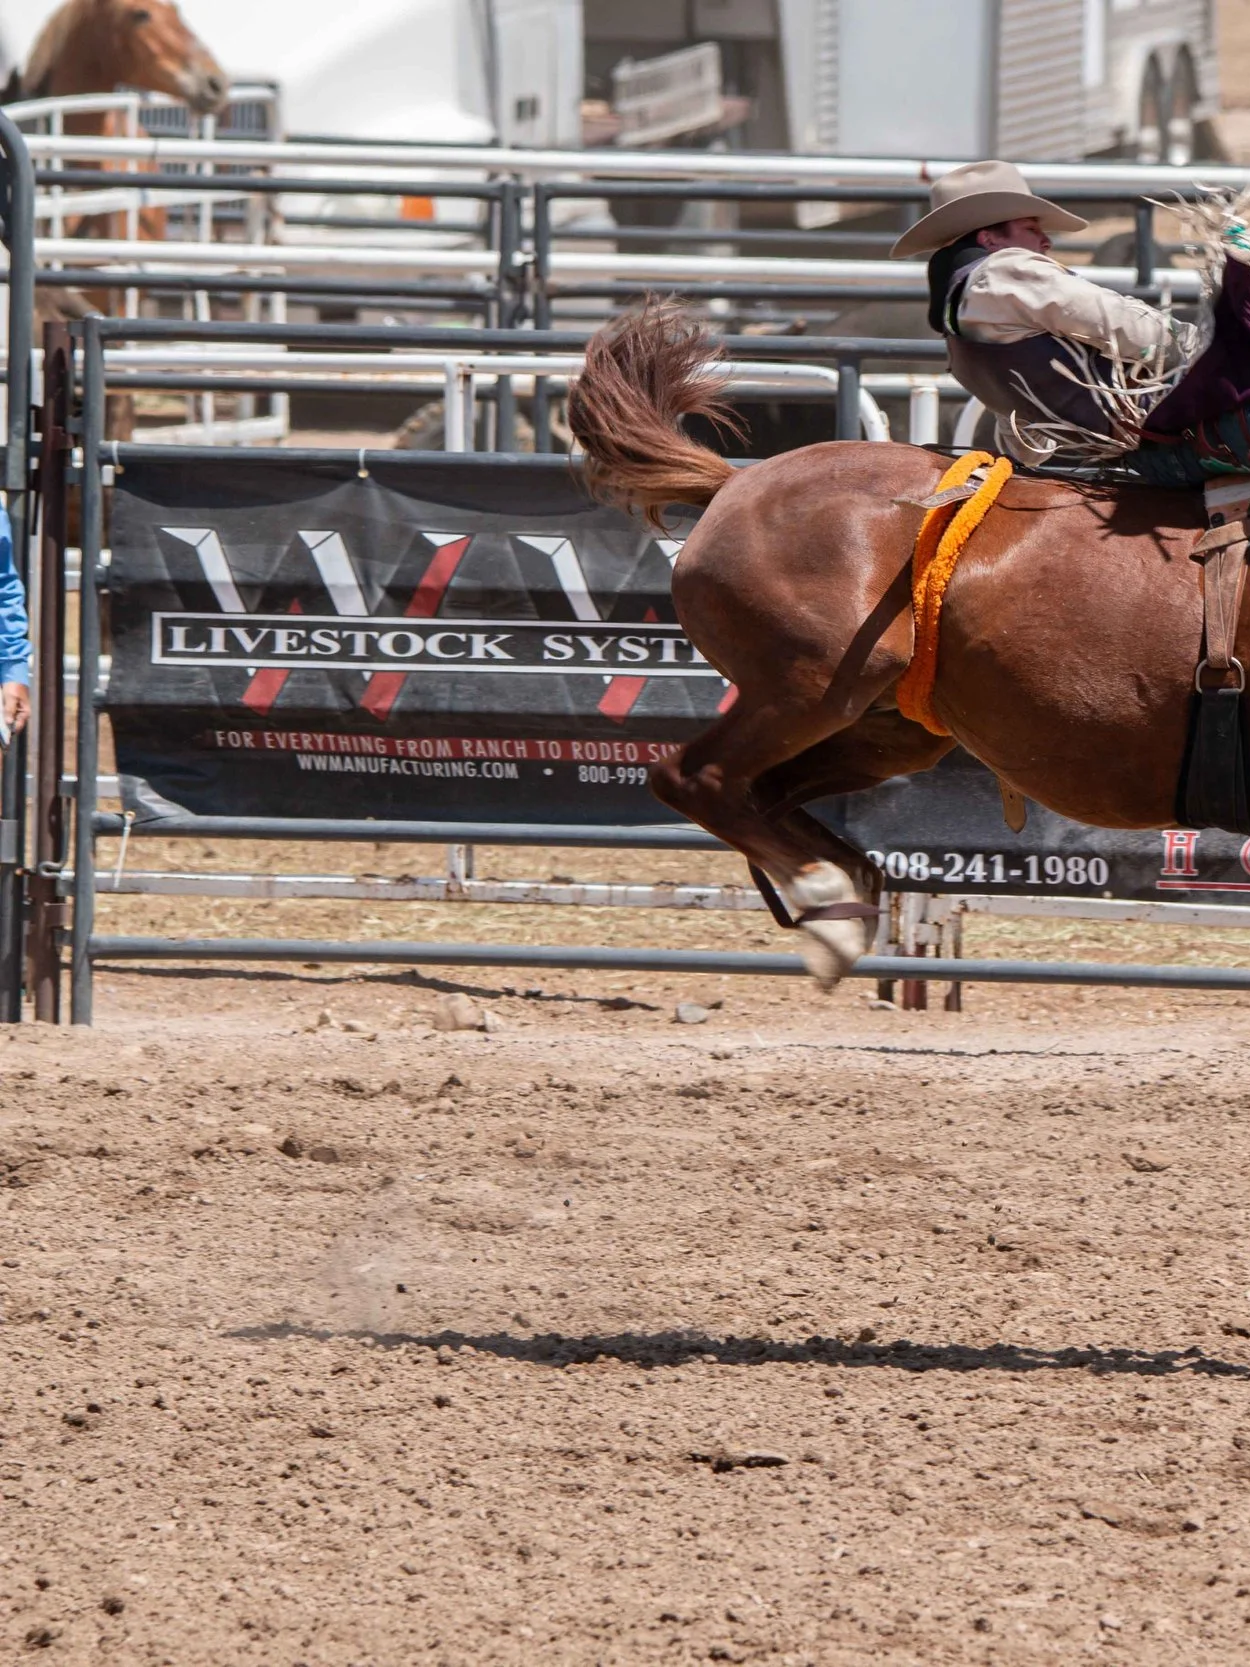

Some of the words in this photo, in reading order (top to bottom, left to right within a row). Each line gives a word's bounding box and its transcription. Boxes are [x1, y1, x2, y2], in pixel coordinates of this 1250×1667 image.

[166, 625, 517, 659] LIVESTOCK
[215, 730, 256, 749] FOR
[263, 731, 386, 755] EVERYTHING
[395, 739, 450, 759] FROM
[461, 739, 526, 759] RANCH
[538, 740, 562, 760] TO
[572, 741, 639, 762] RODEO
[297, 753, 519, 780] WWMANUFACTURING.COM
[578, 764, 648, 786] 800-999
[865, 849, 1110, 886] 208-241-1980
